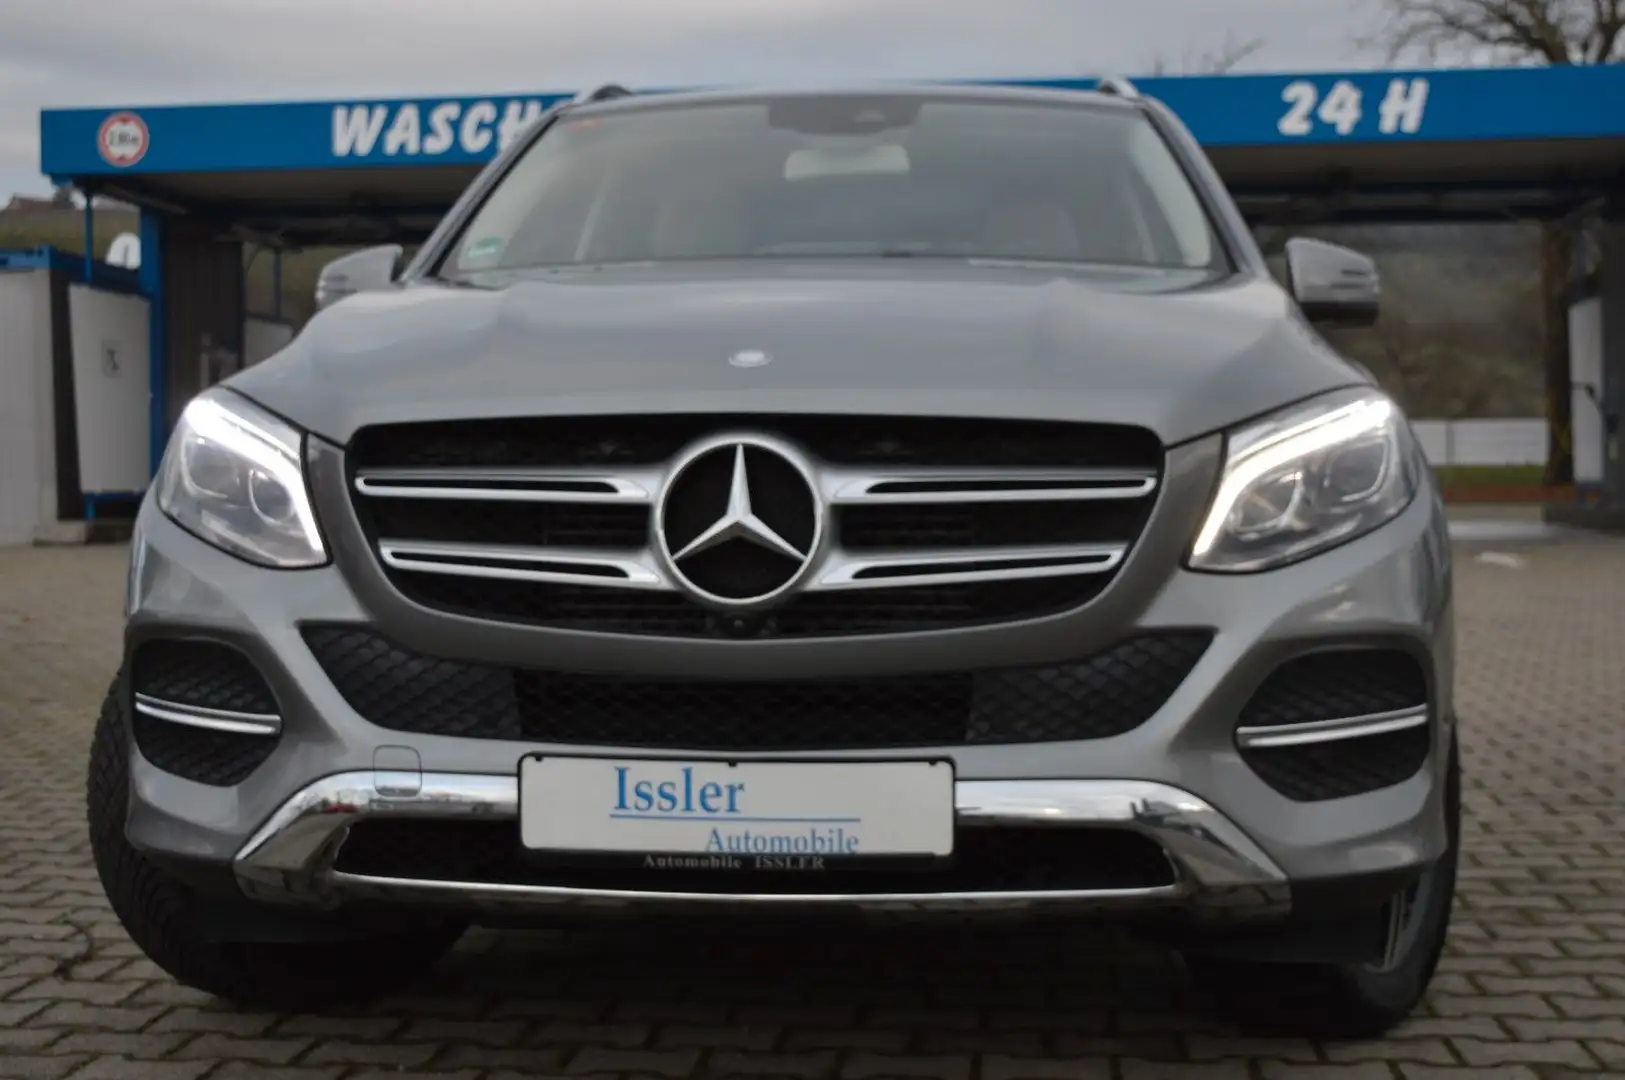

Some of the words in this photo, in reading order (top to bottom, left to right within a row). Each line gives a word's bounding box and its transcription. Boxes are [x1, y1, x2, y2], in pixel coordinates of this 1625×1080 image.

[1277, 80, 1363, 136] 24
[1378, 77, 1430, 134] H
[614, 766, 745, 813] Issler
[705, 827, 860, 854] Automobile
[643, 853, 743, 869] Automobile
[755, 854, 826, 870] ISSLER
